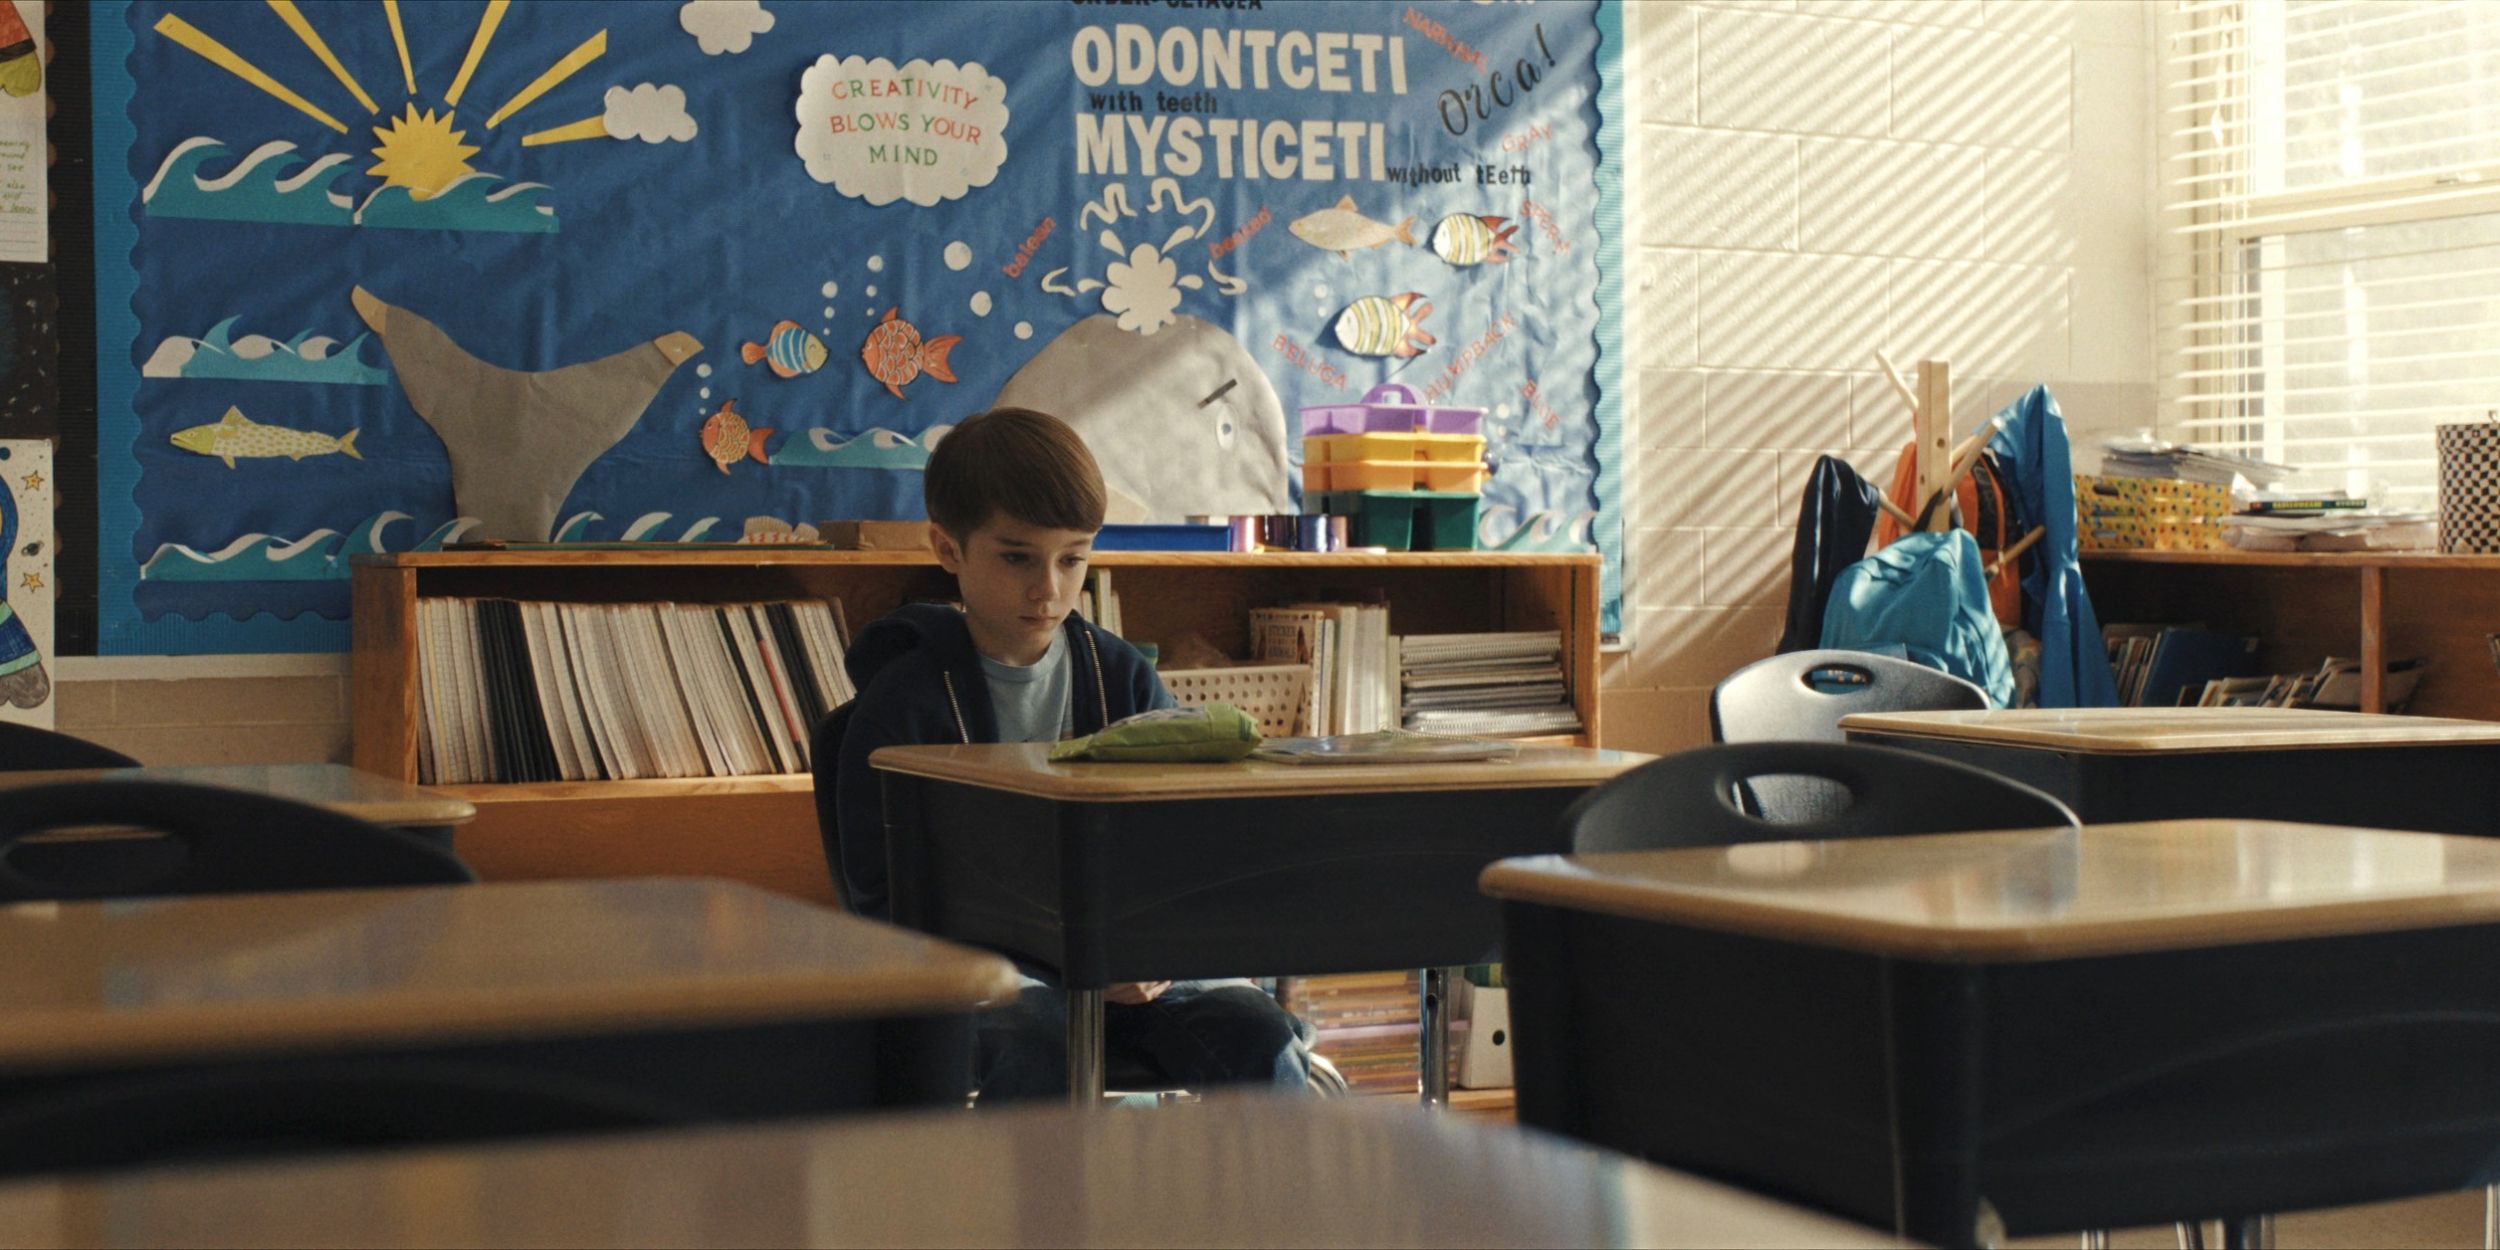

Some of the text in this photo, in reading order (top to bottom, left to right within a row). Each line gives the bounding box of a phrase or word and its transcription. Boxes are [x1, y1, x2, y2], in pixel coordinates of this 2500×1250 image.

[1071, 23, 1409, 95] ODONTCETI
[831, 78, 979, 110] CREATIVITY
[1089, 91, 1218, 113] with teeth
[829, 112, 982, 145] BLOWS YOUR
[869, 144, 938, 167] MIND
[1076, 113, 1386, 181] MYSTICETI
[1271, 333, 1346, 390] BELUGA
